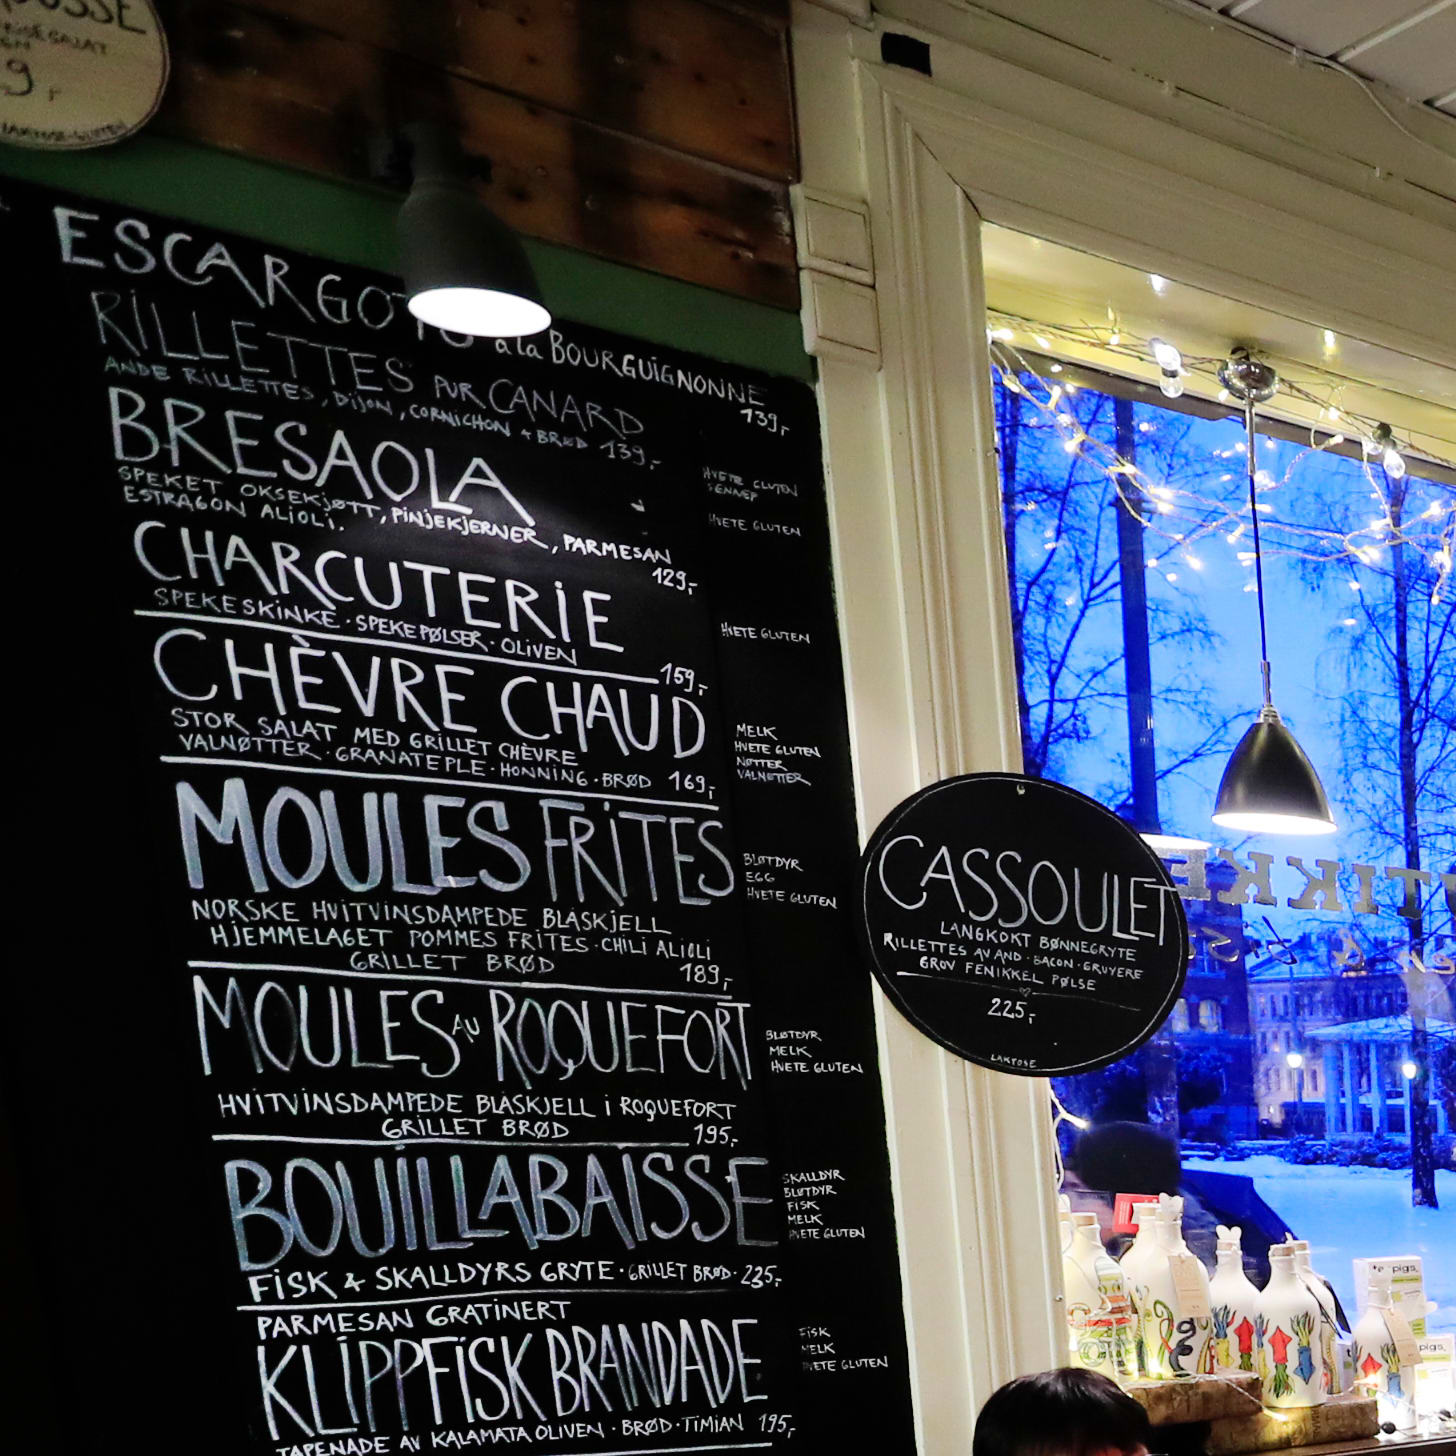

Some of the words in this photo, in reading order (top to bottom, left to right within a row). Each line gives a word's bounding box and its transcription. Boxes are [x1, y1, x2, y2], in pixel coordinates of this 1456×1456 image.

[90, 289, 414, 393] RILLETTES
[488, 379, 644, 440] CANARD
[108, 386, 536, 527] BRESAOLA
[133, 520, 624, 652] CHARCUTERIE
[501, 637, 577, 666] OLIVEN
[153, 627, 479, 734] CHÈVRE
[500, 675, 706, 759] CHAUD
[170, 708, 248, 736] STOR
[257, 716, 339, 743] SALAT
[354, 726, 401, 749] MED
[409, 731, 493, 758] GRILLET
[498, 742, 580, 768] CHÈVRE
[737, 723, 779, 741] MELK
[775, 744, 823, 759] GLUTEN
[179, 733, 322, 762] VALNØTTER
[500, 764, 589, 787] HONNING
[602, 773, 653, 790] BRØD
[736, 756, 788, 770] NØTTER
[175, 776, 532, 896] MOULES
[538, 800, 735, 907] FRITES
[745, 871, 776, 884] EGG
[879, 835, 1177, 947] CASSOULET
[192, 898, 301, 923] NORSKE
[312, 898, 528, 927] HVITVINSDAMPEDE
[542, 908, 673, 935] BLÅSKJELL
[790, 892, 837, 909] GLUTEN
[211, 921, 393, 948] HJEMMELAGET
[409, 929, 498, 949] POMMES
[508, 930, 589, 953] FRITES
[601, 938, 647, 956] CHILI
[656, 939, 712, 961] ALIOLI
[883, 932, 967, 956] RILLETTES
[974, 948, 992, 962] AV
[995, 950, 1022, 964] AND
[1033, 954, 1074, 969] BACON
[1082, 961, 1144, 980] GRUYERE
[940, 920, 1032, 948] LANGKOKT
[1039, 935, 1137, 961] BØNNEGRYTE
[920, 955, 956, 971] GROV
[965, 962, 1044, 985] FENIKKEL
[1051, 975, 1097, 991] PØLSE
[192, 974, 461, 1078] MOULES
[452, 1014, 480, 1043] AU
[489, 989, 752, 1090] ROQUEFORT
[218, 1087, 463, 1119] HVITVINSDAMPEDE
[620, 1097, 737, 1121] ROQUEFORT
[223, 1146, 780, 1272] BOUILLABAISSE
[788, 1200, 820, 1212] FISK
[788, 1212, 823, 1225] MELK
[248, 1268, 338, 1303] FISK
[375, 1261, 532, 1291] SKALLDYRS
[540, 1260, 615, 1283] GRYTE
[627, 1260, 688, 1281] GRILLET
[693, 1265, 732, 1282] BRØD
[257, 1308, 415, 1340] PARMESAN
[425, 1298, 572, 1327] GRATINERT
[256, 1332, 548, 1442] KLIPPFISK
[545, 1318, 769, 1417] BRANDADE
